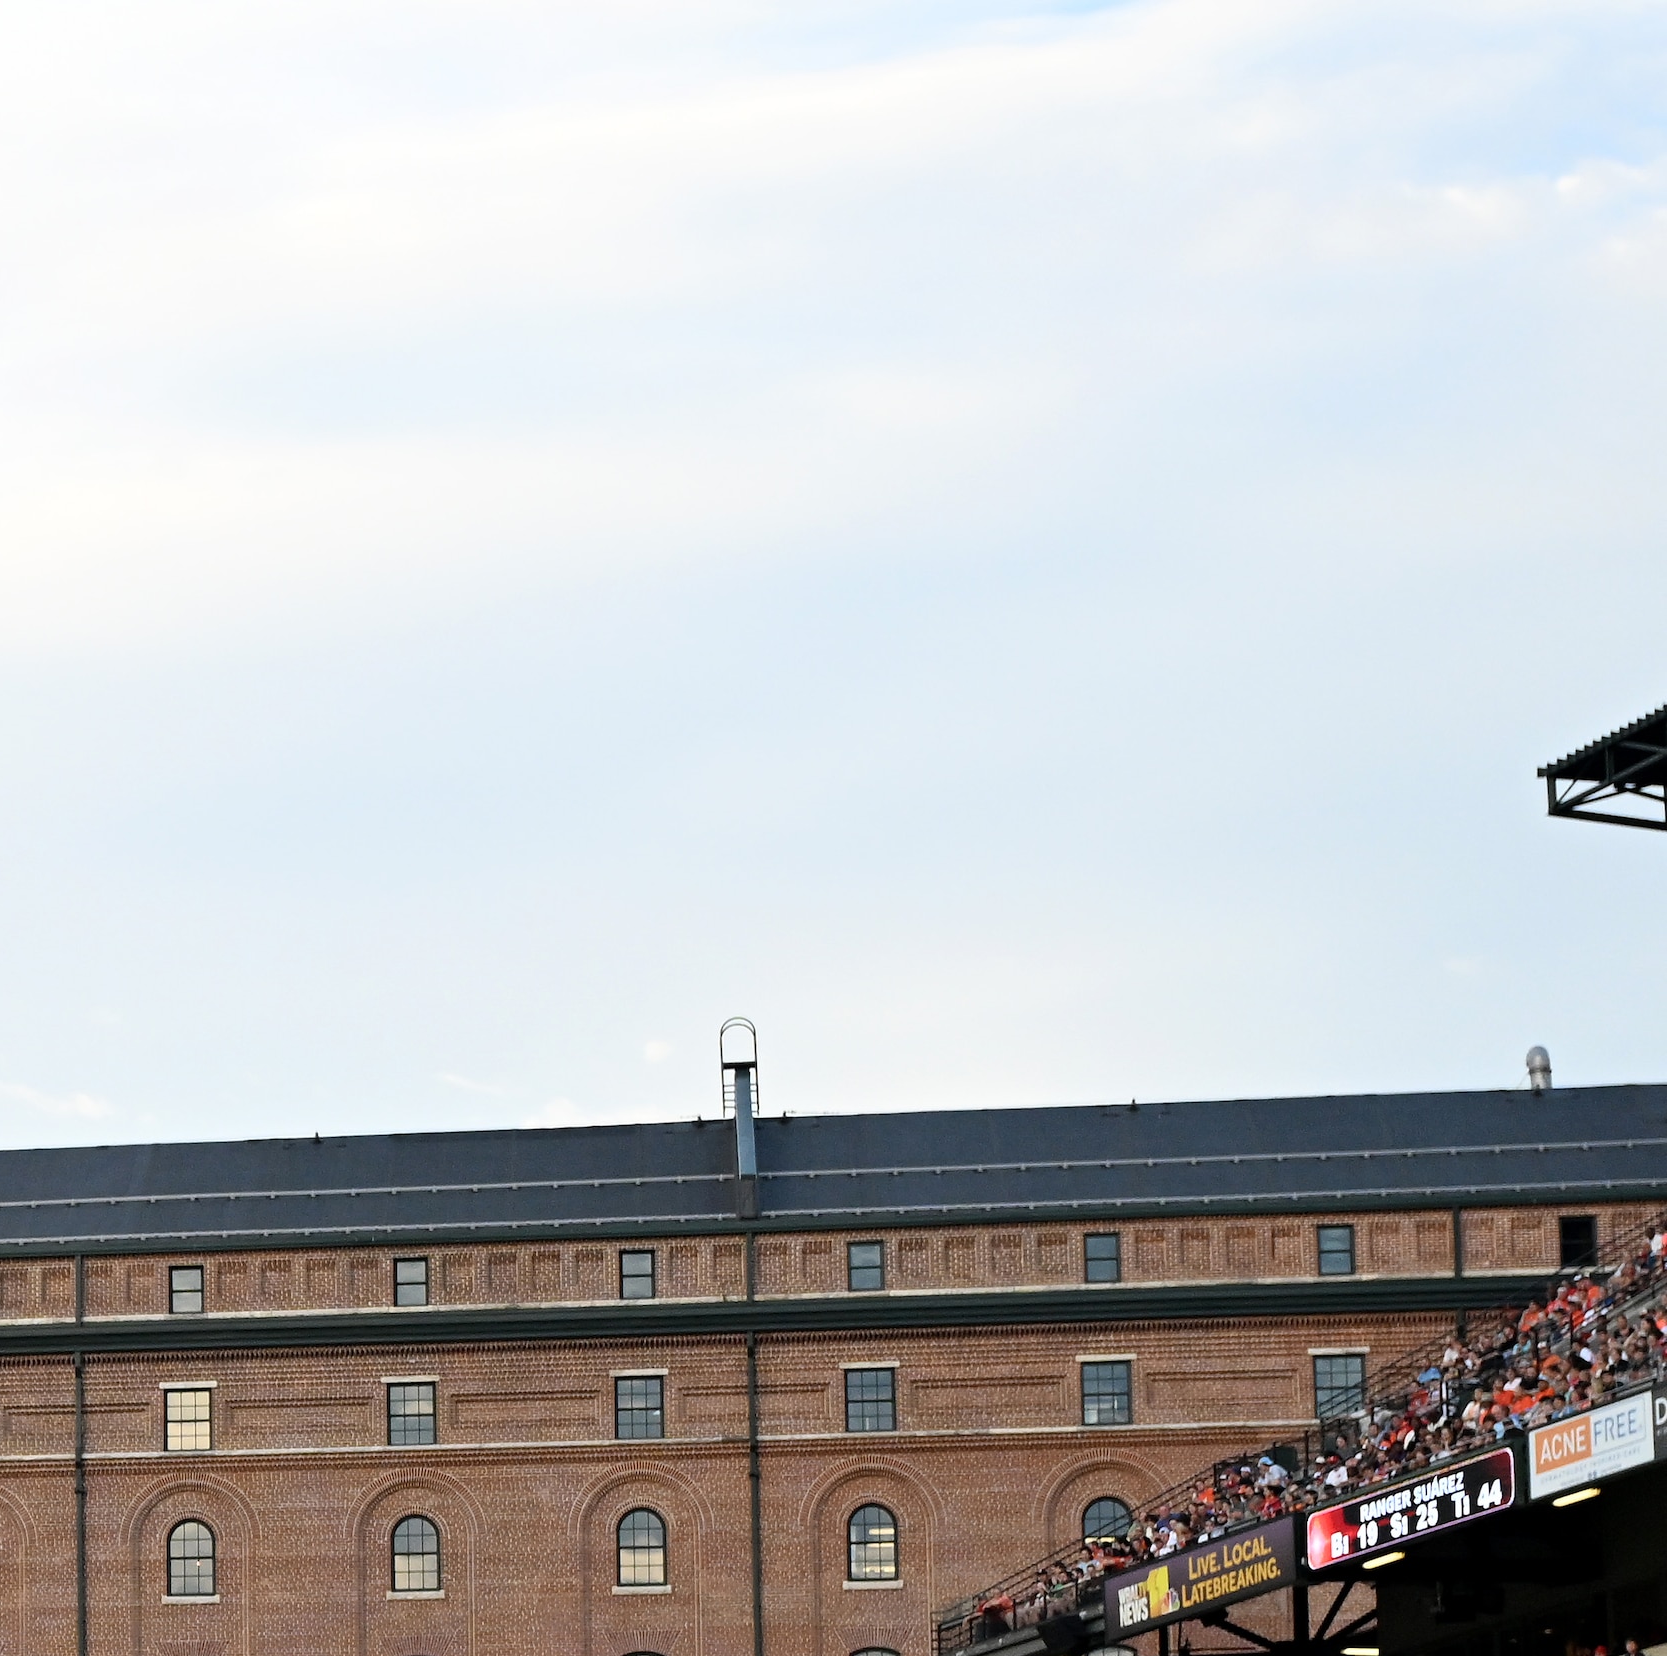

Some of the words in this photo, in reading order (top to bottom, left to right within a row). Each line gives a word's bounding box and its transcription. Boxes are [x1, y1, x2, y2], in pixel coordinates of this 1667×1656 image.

[1540, 1425, 1586, 1465] ACNE
[1594, 1408, 1637, 1446] FREE
[1357, 1521, 1378, 1549] 19
[1416, 1500, 1438, 1531] 25
[1477, 1479, 1502, 1509] 44
[1360, 1489, 1411, 1523] RANGER
[1414, 1471, 1464, 1503] SUÁREZ
[1119, 1597, 1148, 1628] NEWS
